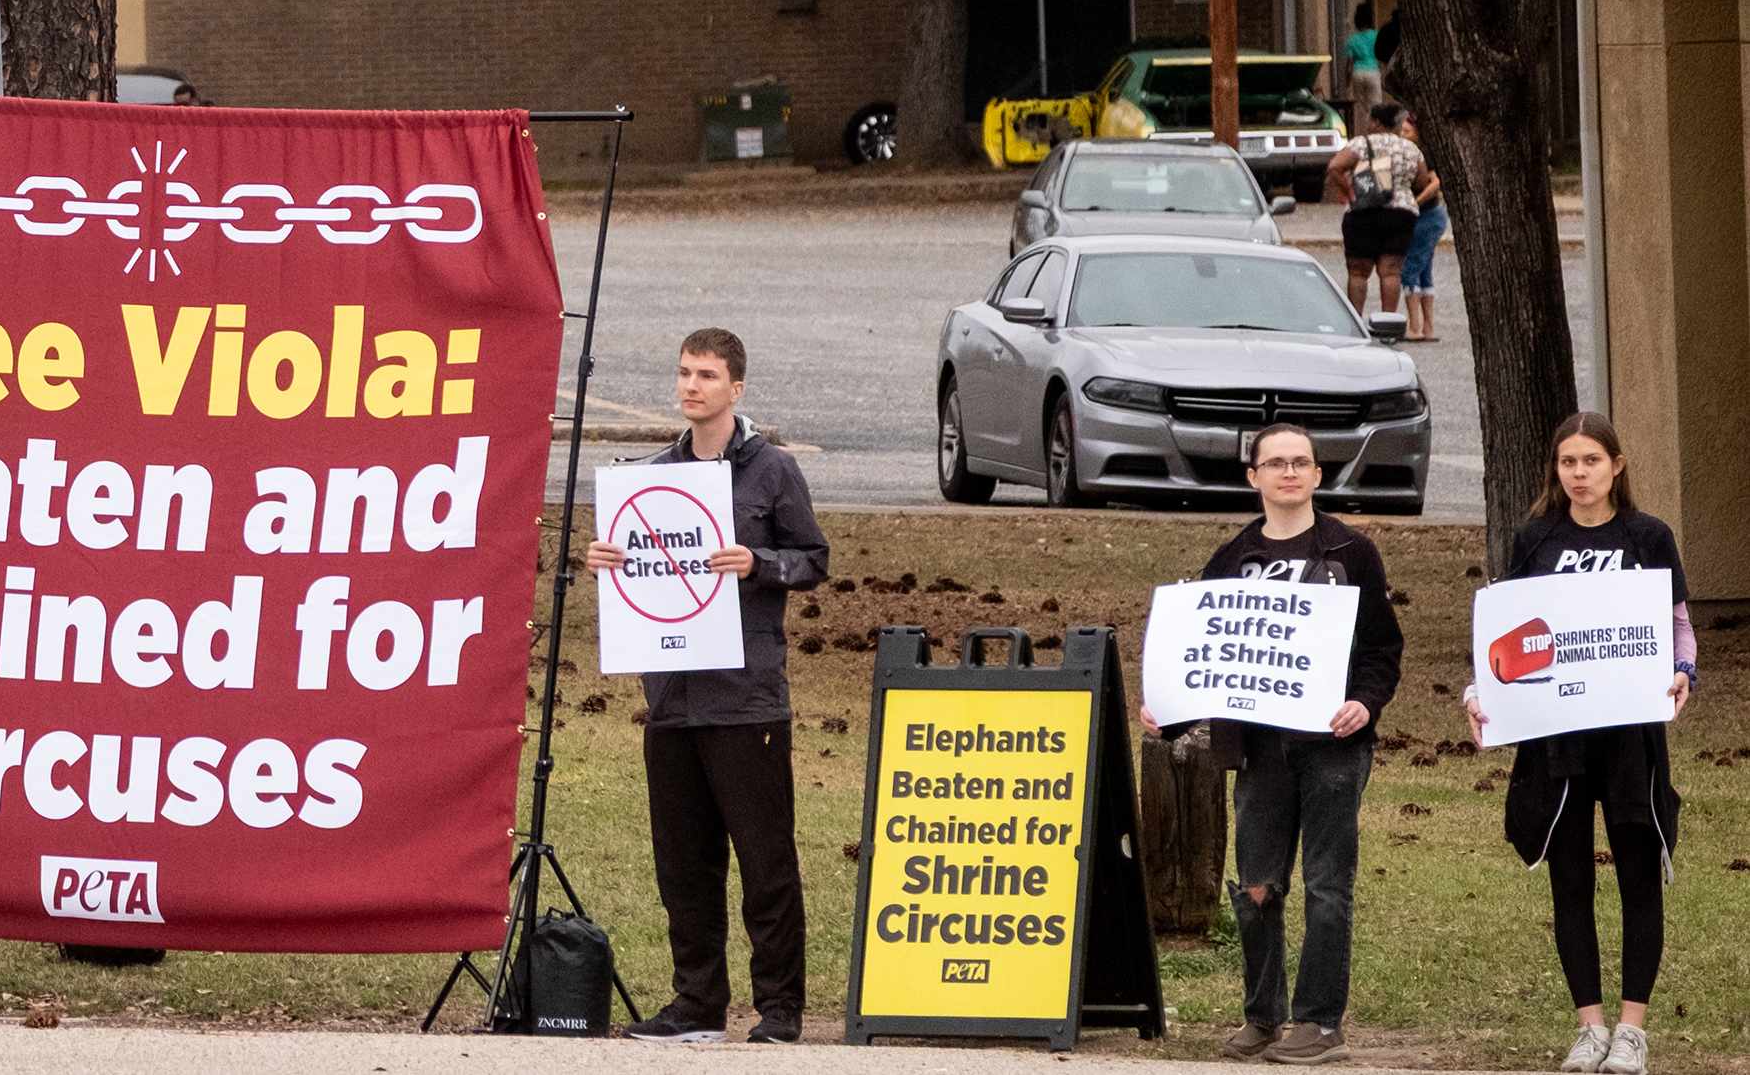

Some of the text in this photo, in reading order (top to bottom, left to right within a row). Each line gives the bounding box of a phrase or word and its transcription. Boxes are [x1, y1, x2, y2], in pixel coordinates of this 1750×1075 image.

[122, 303, 482, 420] Viola:
[243, 435, 491, 555] and
[627, 527, 703, 550] Animal
[623, 557, 713, 578] Circuses
[1241, 559, 1307, 582] PeT
[1196, 590, 1313, 616] Animals
[295, 575, 484, 692] for
[1205, 616, 1297, 641] Suffer
[1522, 626, 1655, 654] STOP SHRINERS' CRUEL
[1184, 643, 1311, 671] at Shrine
[1556, 641, 1658, 664] ANIMAL CIRCUSES
[1185, 669, 1304, 699] Circuses
[905, 724, 1066, 757] Elephants
[892, 771, 1074, 801] Beaten and
[886, 815, 1073, 846] Chained for
[901, 855, 1048, 896] Shrine
[876, 903, 1066, 946] Circuses
[538, 1017, 588, 1030] ZNCMRR
